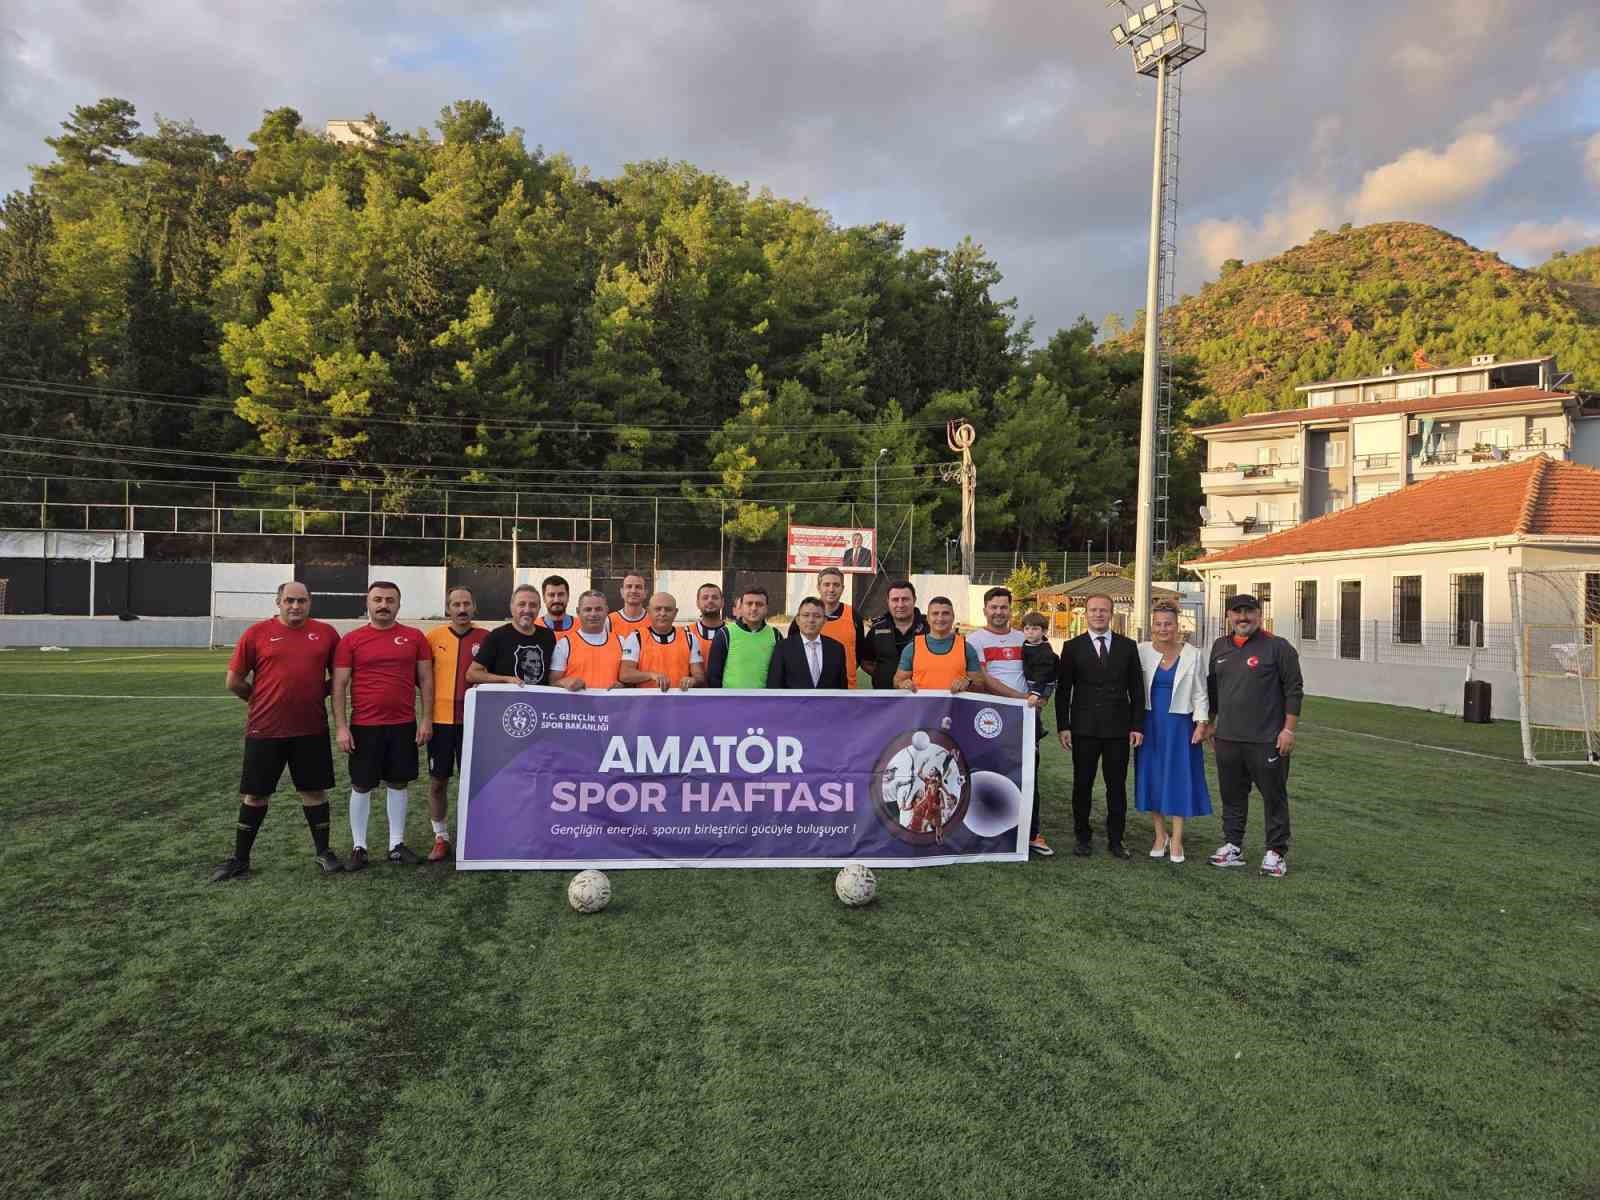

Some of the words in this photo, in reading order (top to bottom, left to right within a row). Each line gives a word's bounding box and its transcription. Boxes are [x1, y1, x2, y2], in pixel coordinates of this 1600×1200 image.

[541, 712, 557, 721] T.C.
[559, 712, 596, 724] GENÇLİK
[599, 714, 609, 723] VE
[541, 721, 563, 730] SPOR
[565, 722, 609, 733] BAKANLIĞI
[598, 727, 804, 774] AMATÖR
[550, 781, 667, 813] SPOR
[681, 782, 854, 813] HAFTASI
[550, 823, 603, 838] Gençliğin
[606, 824, 648, 837] enerjisi,
[652, 825, 691, 838] sporun
[694, 823, 748, 838] birleştirici
[751, 823, 793, 837] gücüyle
[796, 823, 849, 838] buluşuyor
